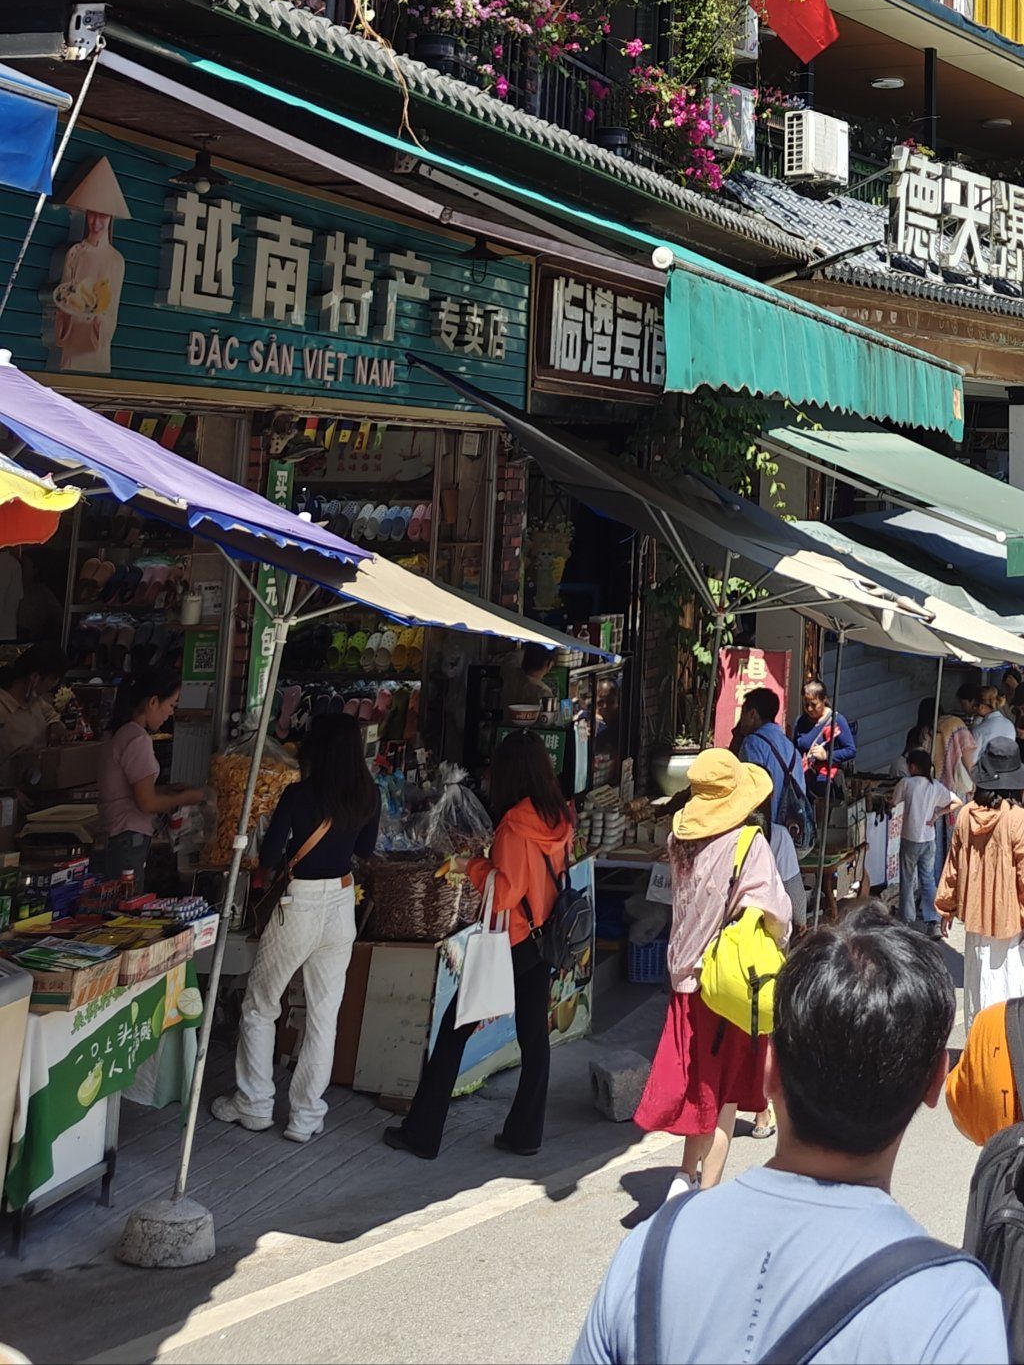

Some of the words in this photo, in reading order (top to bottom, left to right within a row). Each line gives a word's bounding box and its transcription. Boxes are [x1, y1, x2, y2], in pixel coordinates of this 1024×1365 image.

[158, 191, 432, 342] 越南特产
[433, 296, 508, 360] 专卖店
[354, 354, 396, 389] NAM
